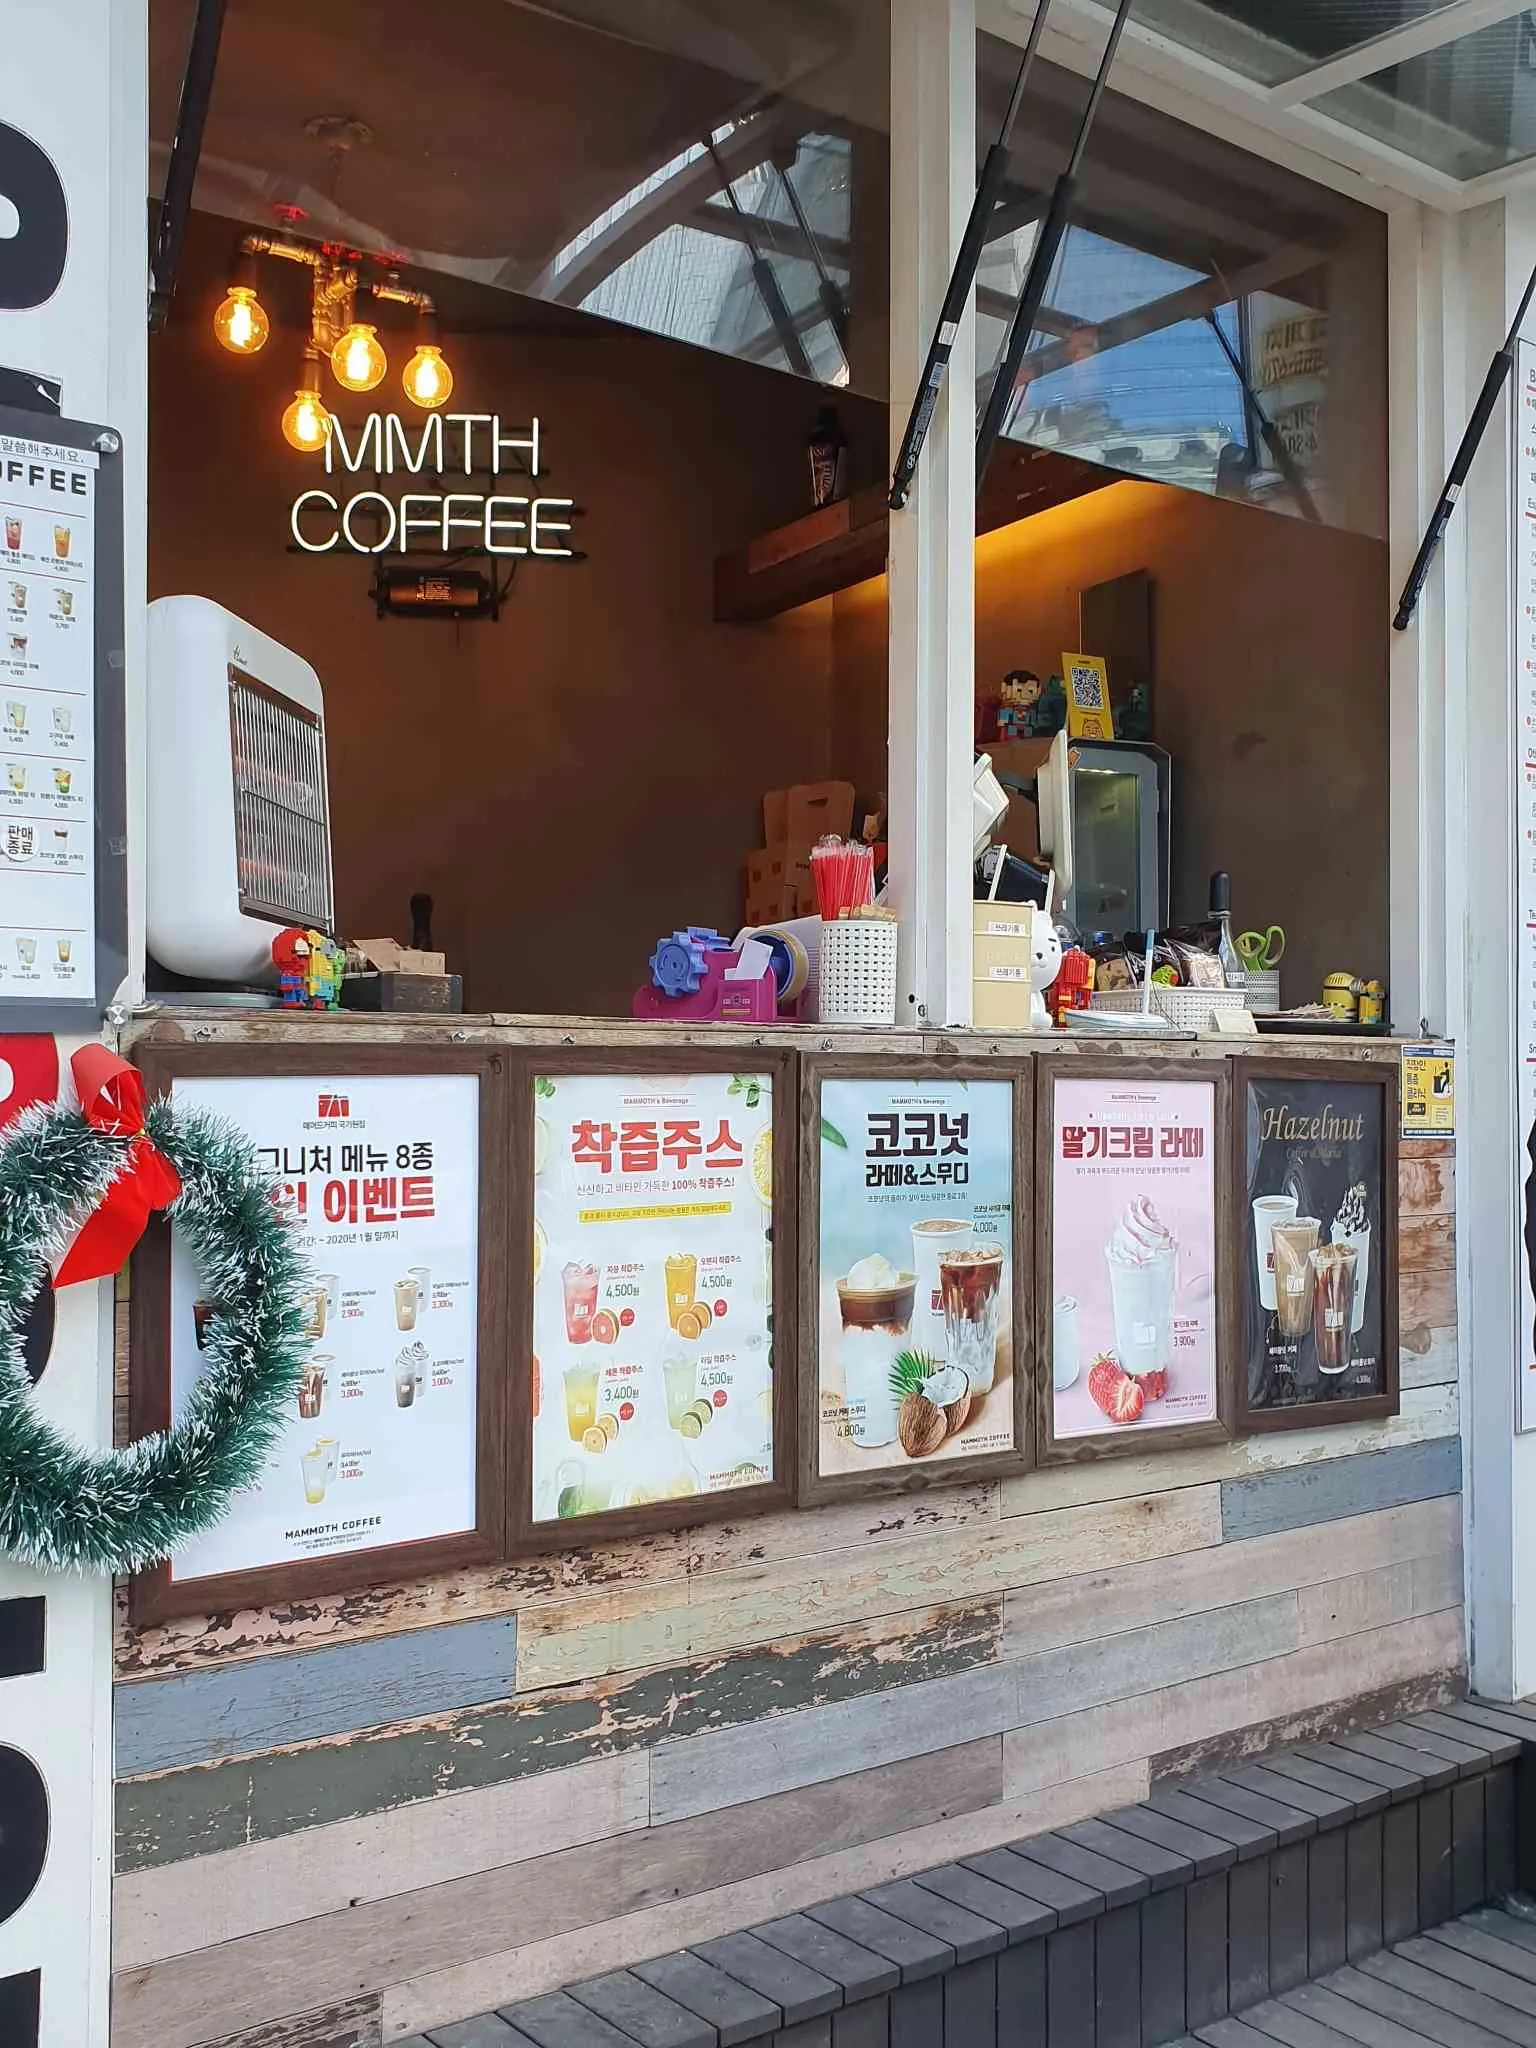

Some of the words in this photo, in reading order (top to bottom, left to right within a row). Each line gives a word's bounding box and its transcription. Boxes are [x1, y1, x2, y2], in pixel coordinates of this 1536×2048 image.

[323, 412, 540, 476] MMTH
[0, 460, 87, 496] FFEE
[291, 489, 574, 556] COFFEE
[8, 825, 33, 840] 판매
[8, 840, 33, 855] 종료
[865, 1112, 969, 1157] 코코넛
[1260, 1103, 1367, 1141] Hazelnut
[571, 1119, 744, 1174] 착즙주스
[1062, 1126, 1154, 1159] 딸기크림
[1160, 1127, 1204, 1159] 라떼
[250, 1144, 332, 1176] 그니처
[341, 1143, 389, 1173] 메뉴
[395, 1141, 434, 1171] 8종
[671, 1178, 698, 1191] 100%
[698, 1175, 736, 1189] 착즙주스!
[865, 1162, 969, 1187] 라떼&스무디
[323, 1175, 435, 1224] 이벤트
[326, 1233, 357, 1245] 2020년
[360, 1231, 373, 1242] 1월
[606, 1283, 640, 1298] 4,500원
[701, 1275, 733, 1289] 4,500원
[700, 1371, 734, 1387] 4,500원
[604, 1385, 640, 1401] 3,400원
[285, 1523, 338, 1539] MAMMOTH
[342, 1515, 382, 1530] COFFEE
